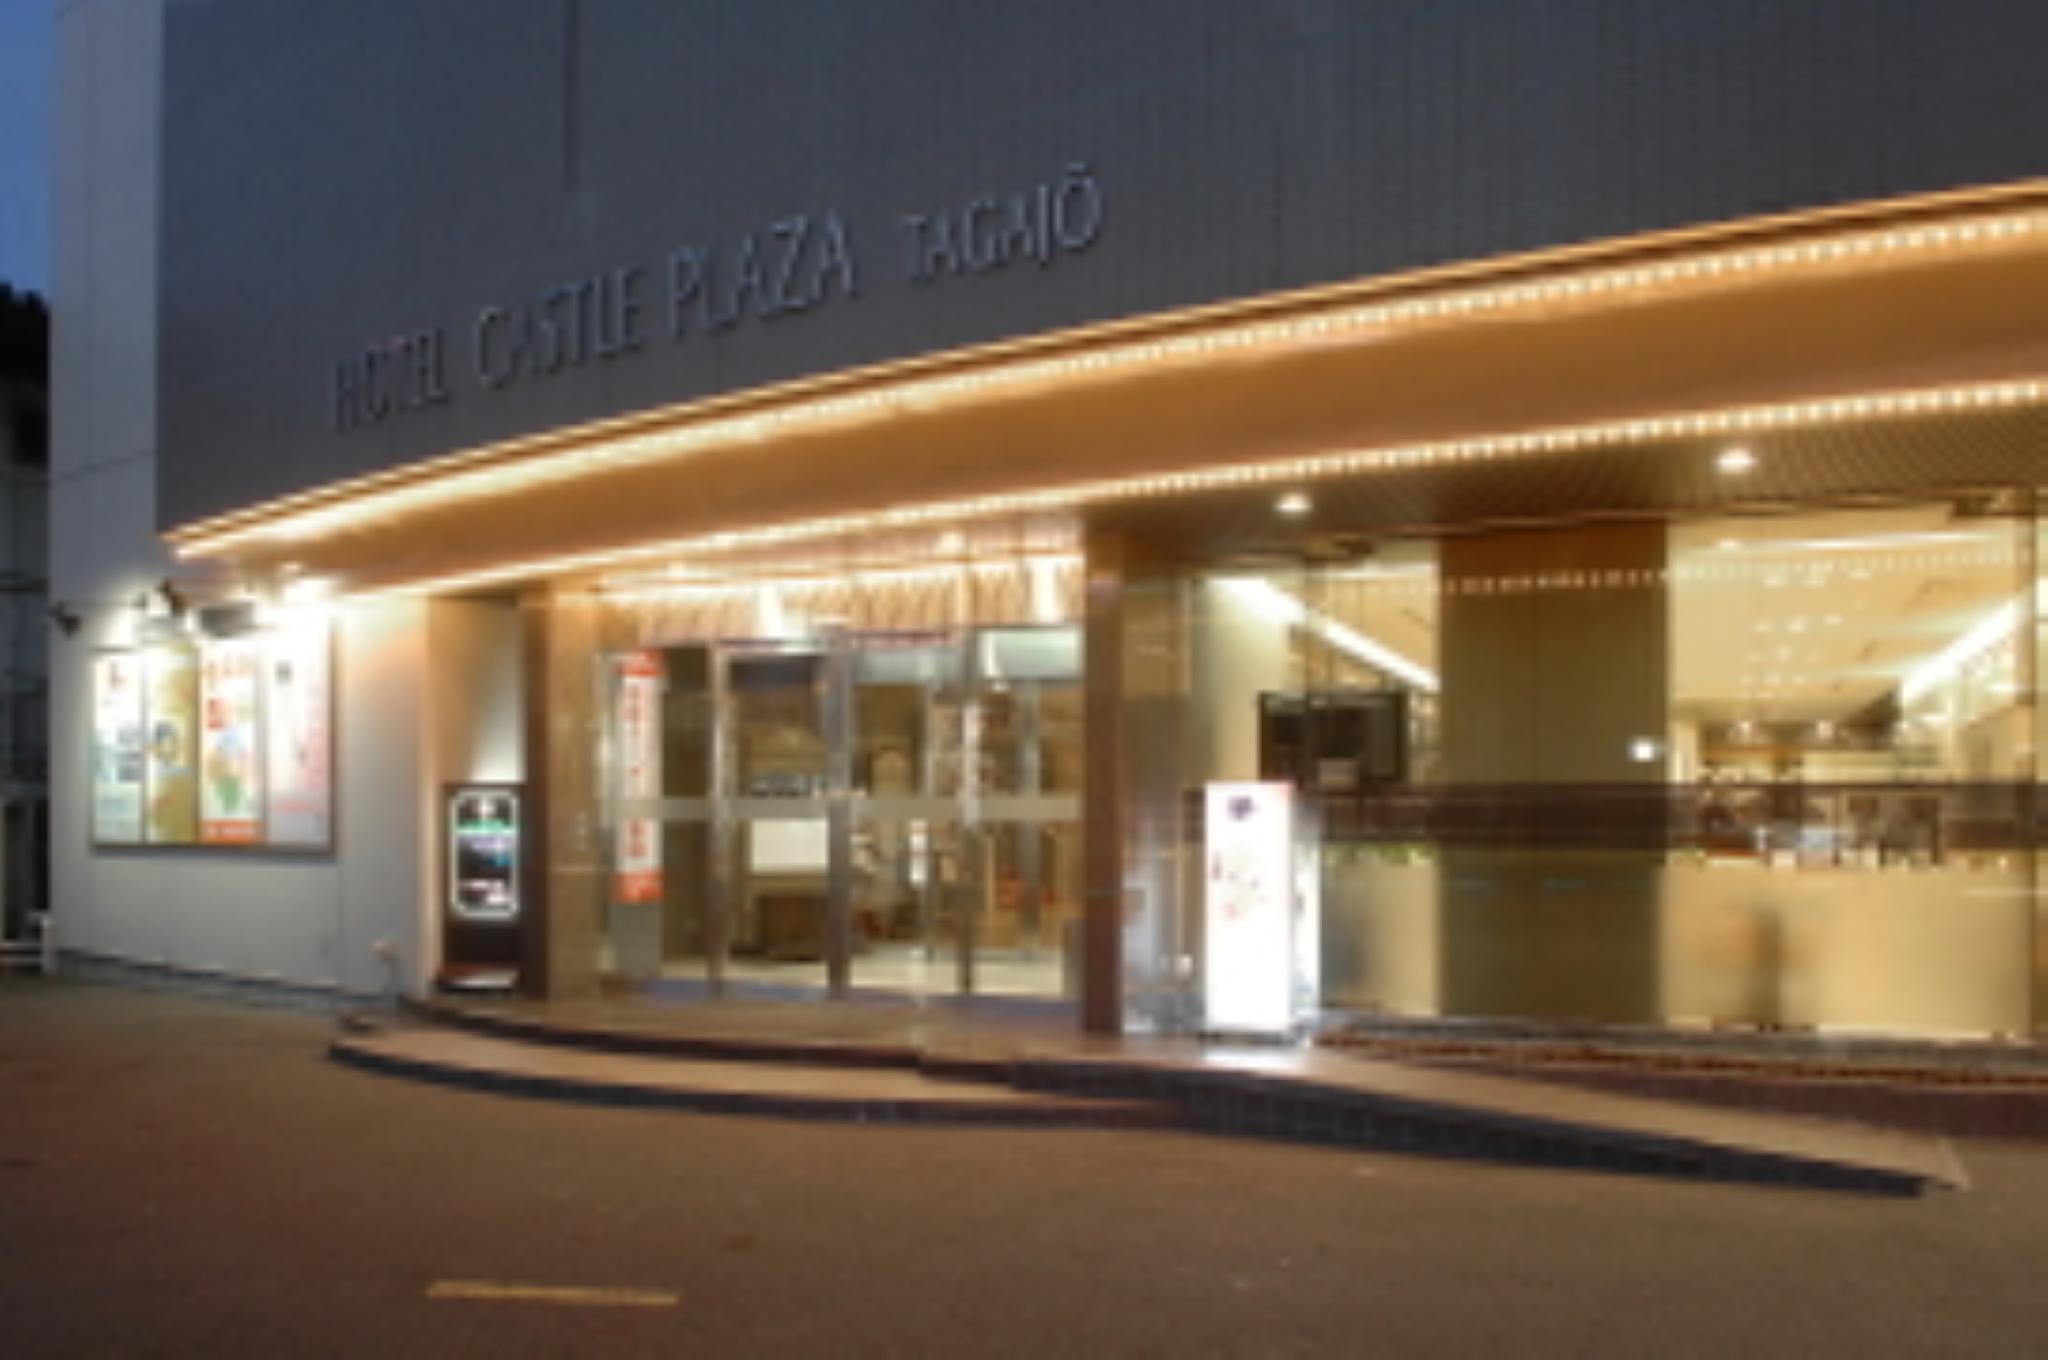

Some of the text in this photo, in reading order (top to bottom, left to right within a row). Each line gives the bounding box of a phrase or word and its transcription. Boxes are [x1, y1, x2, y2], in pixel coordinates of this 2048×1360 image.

[334, 326, 448, 433] HOTEL
[474, 264, 647, 391] CASTLE
[667, 207, 858, 340] PLAZA
